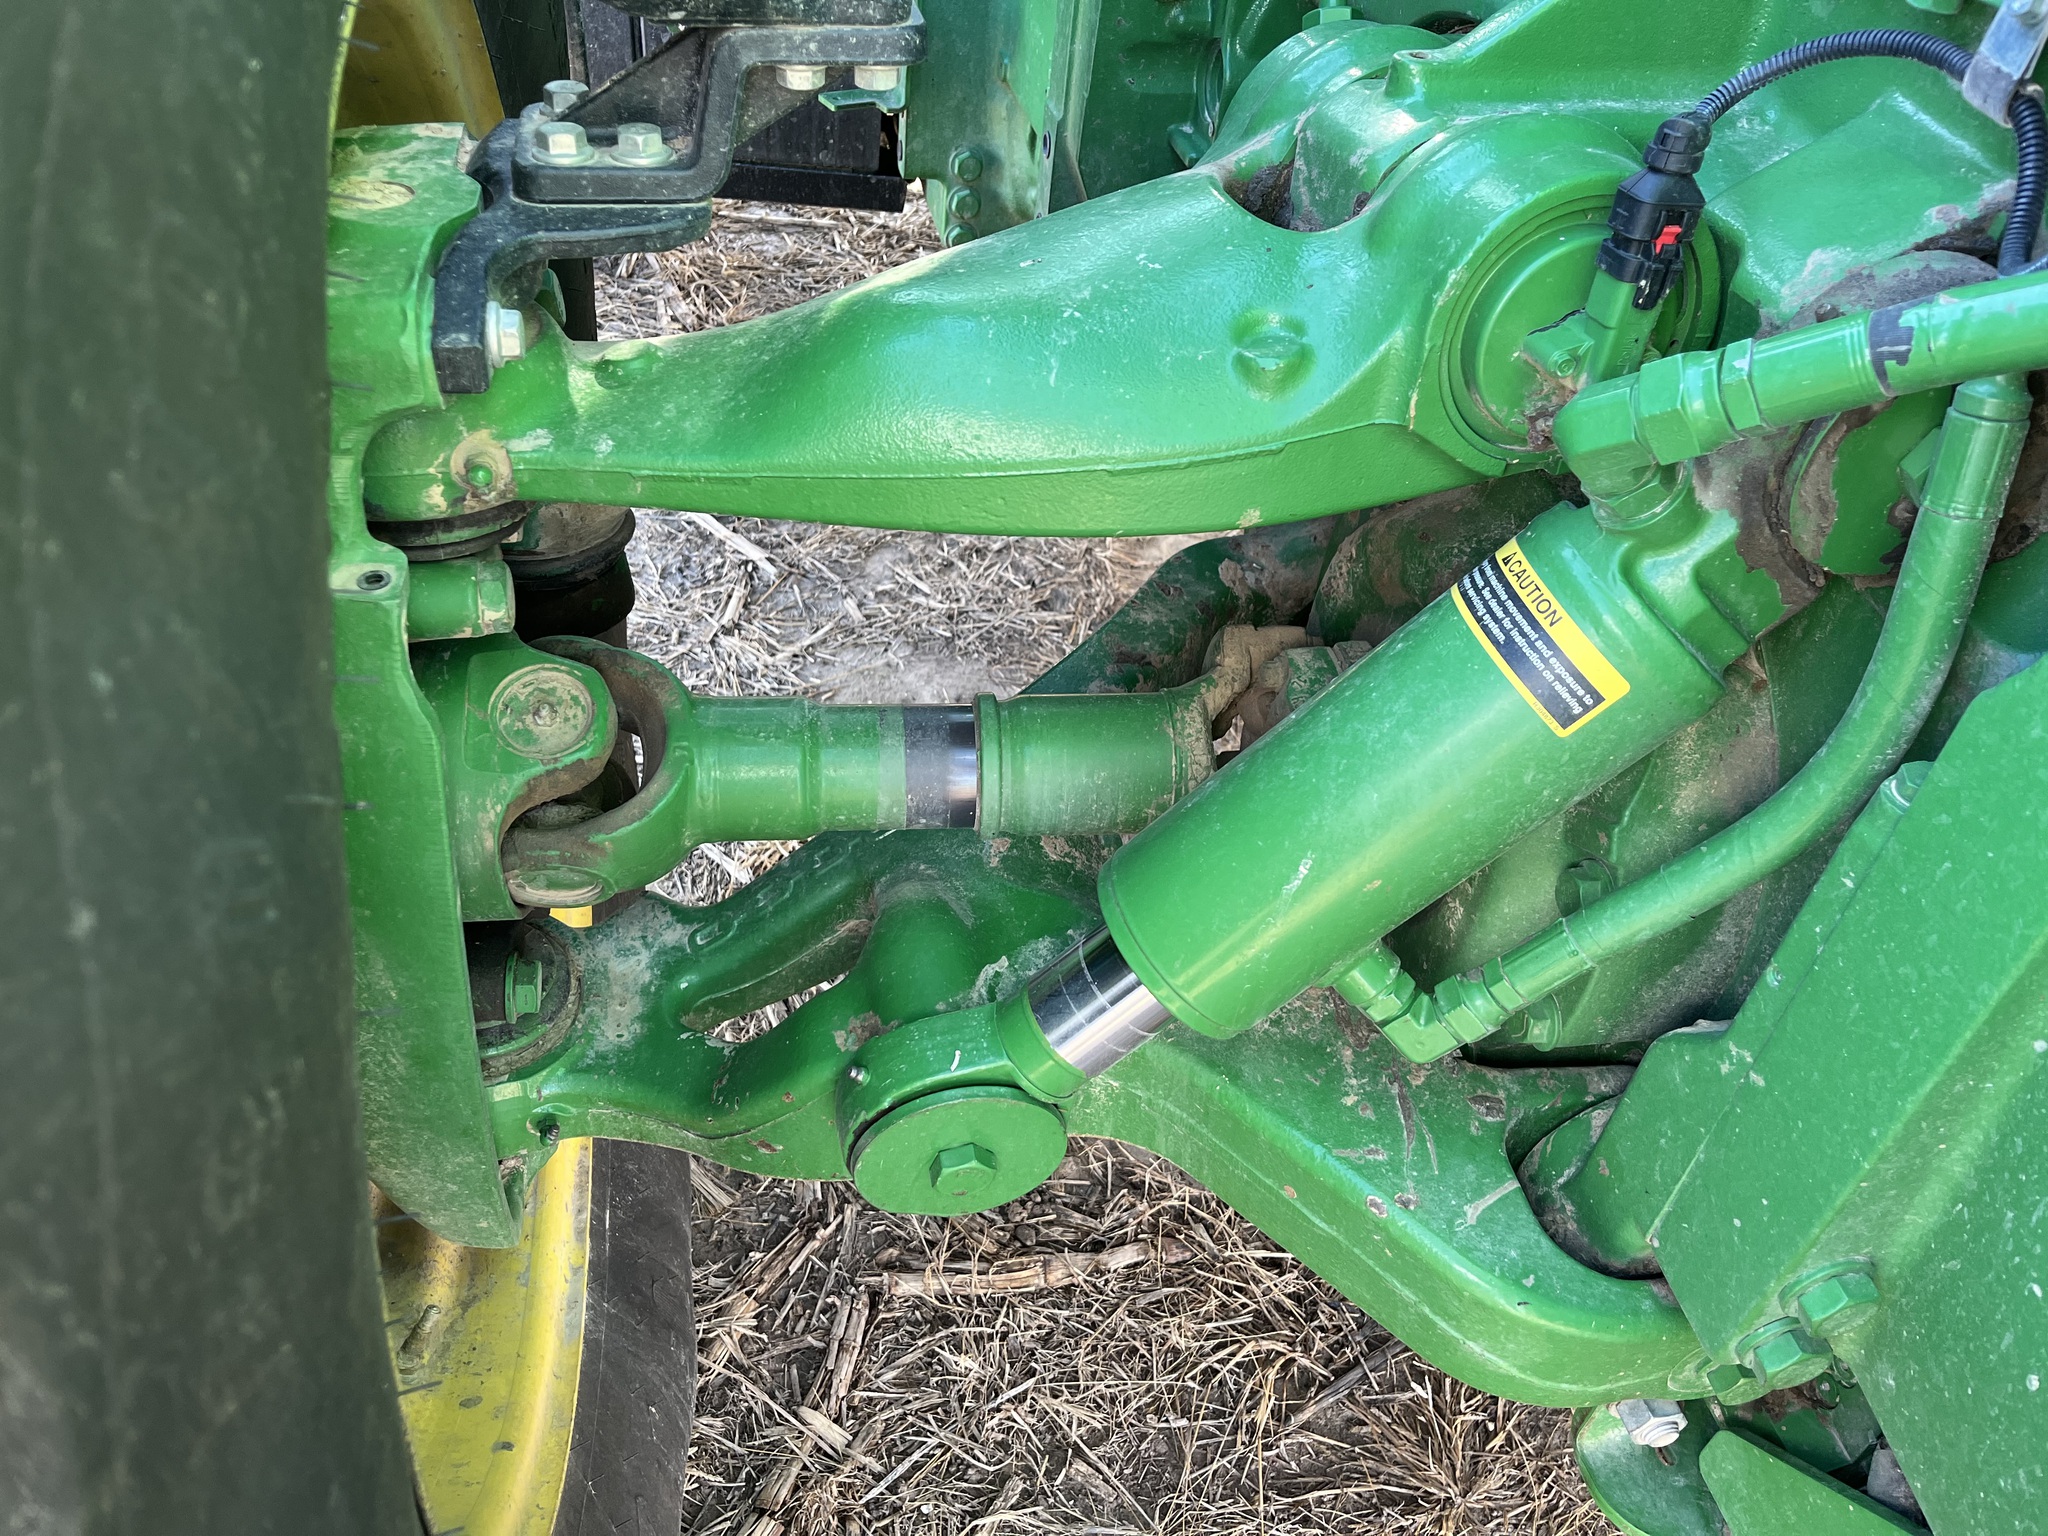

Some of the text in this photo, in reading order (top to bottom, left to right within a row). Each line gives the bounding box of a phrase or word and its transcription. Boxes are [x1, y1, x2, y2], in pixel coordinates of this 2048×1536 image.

[1467, 588, 1487, 616] servicing
[1482, 613, 1506, 644] system.
[1488, 574, 1508, 601] machine
[1504, 599, 1539, 641] movement
[1534, 640, 1553, 658] and
[1549, 657, 1585, 696] exposure
[1583, 694, 1593, 705] to
[1508, 560, 1563, 627] CAUTION
[1482, 587, 1492, 600] See
[1488, 599, 1506, 619] dealer
[1502, 617, 1514, 630] for
[1510, 628, 1545, 671] instruction
[1542, 670, 1555, 682] on
[1551, 681, 1583, 715] relieving
